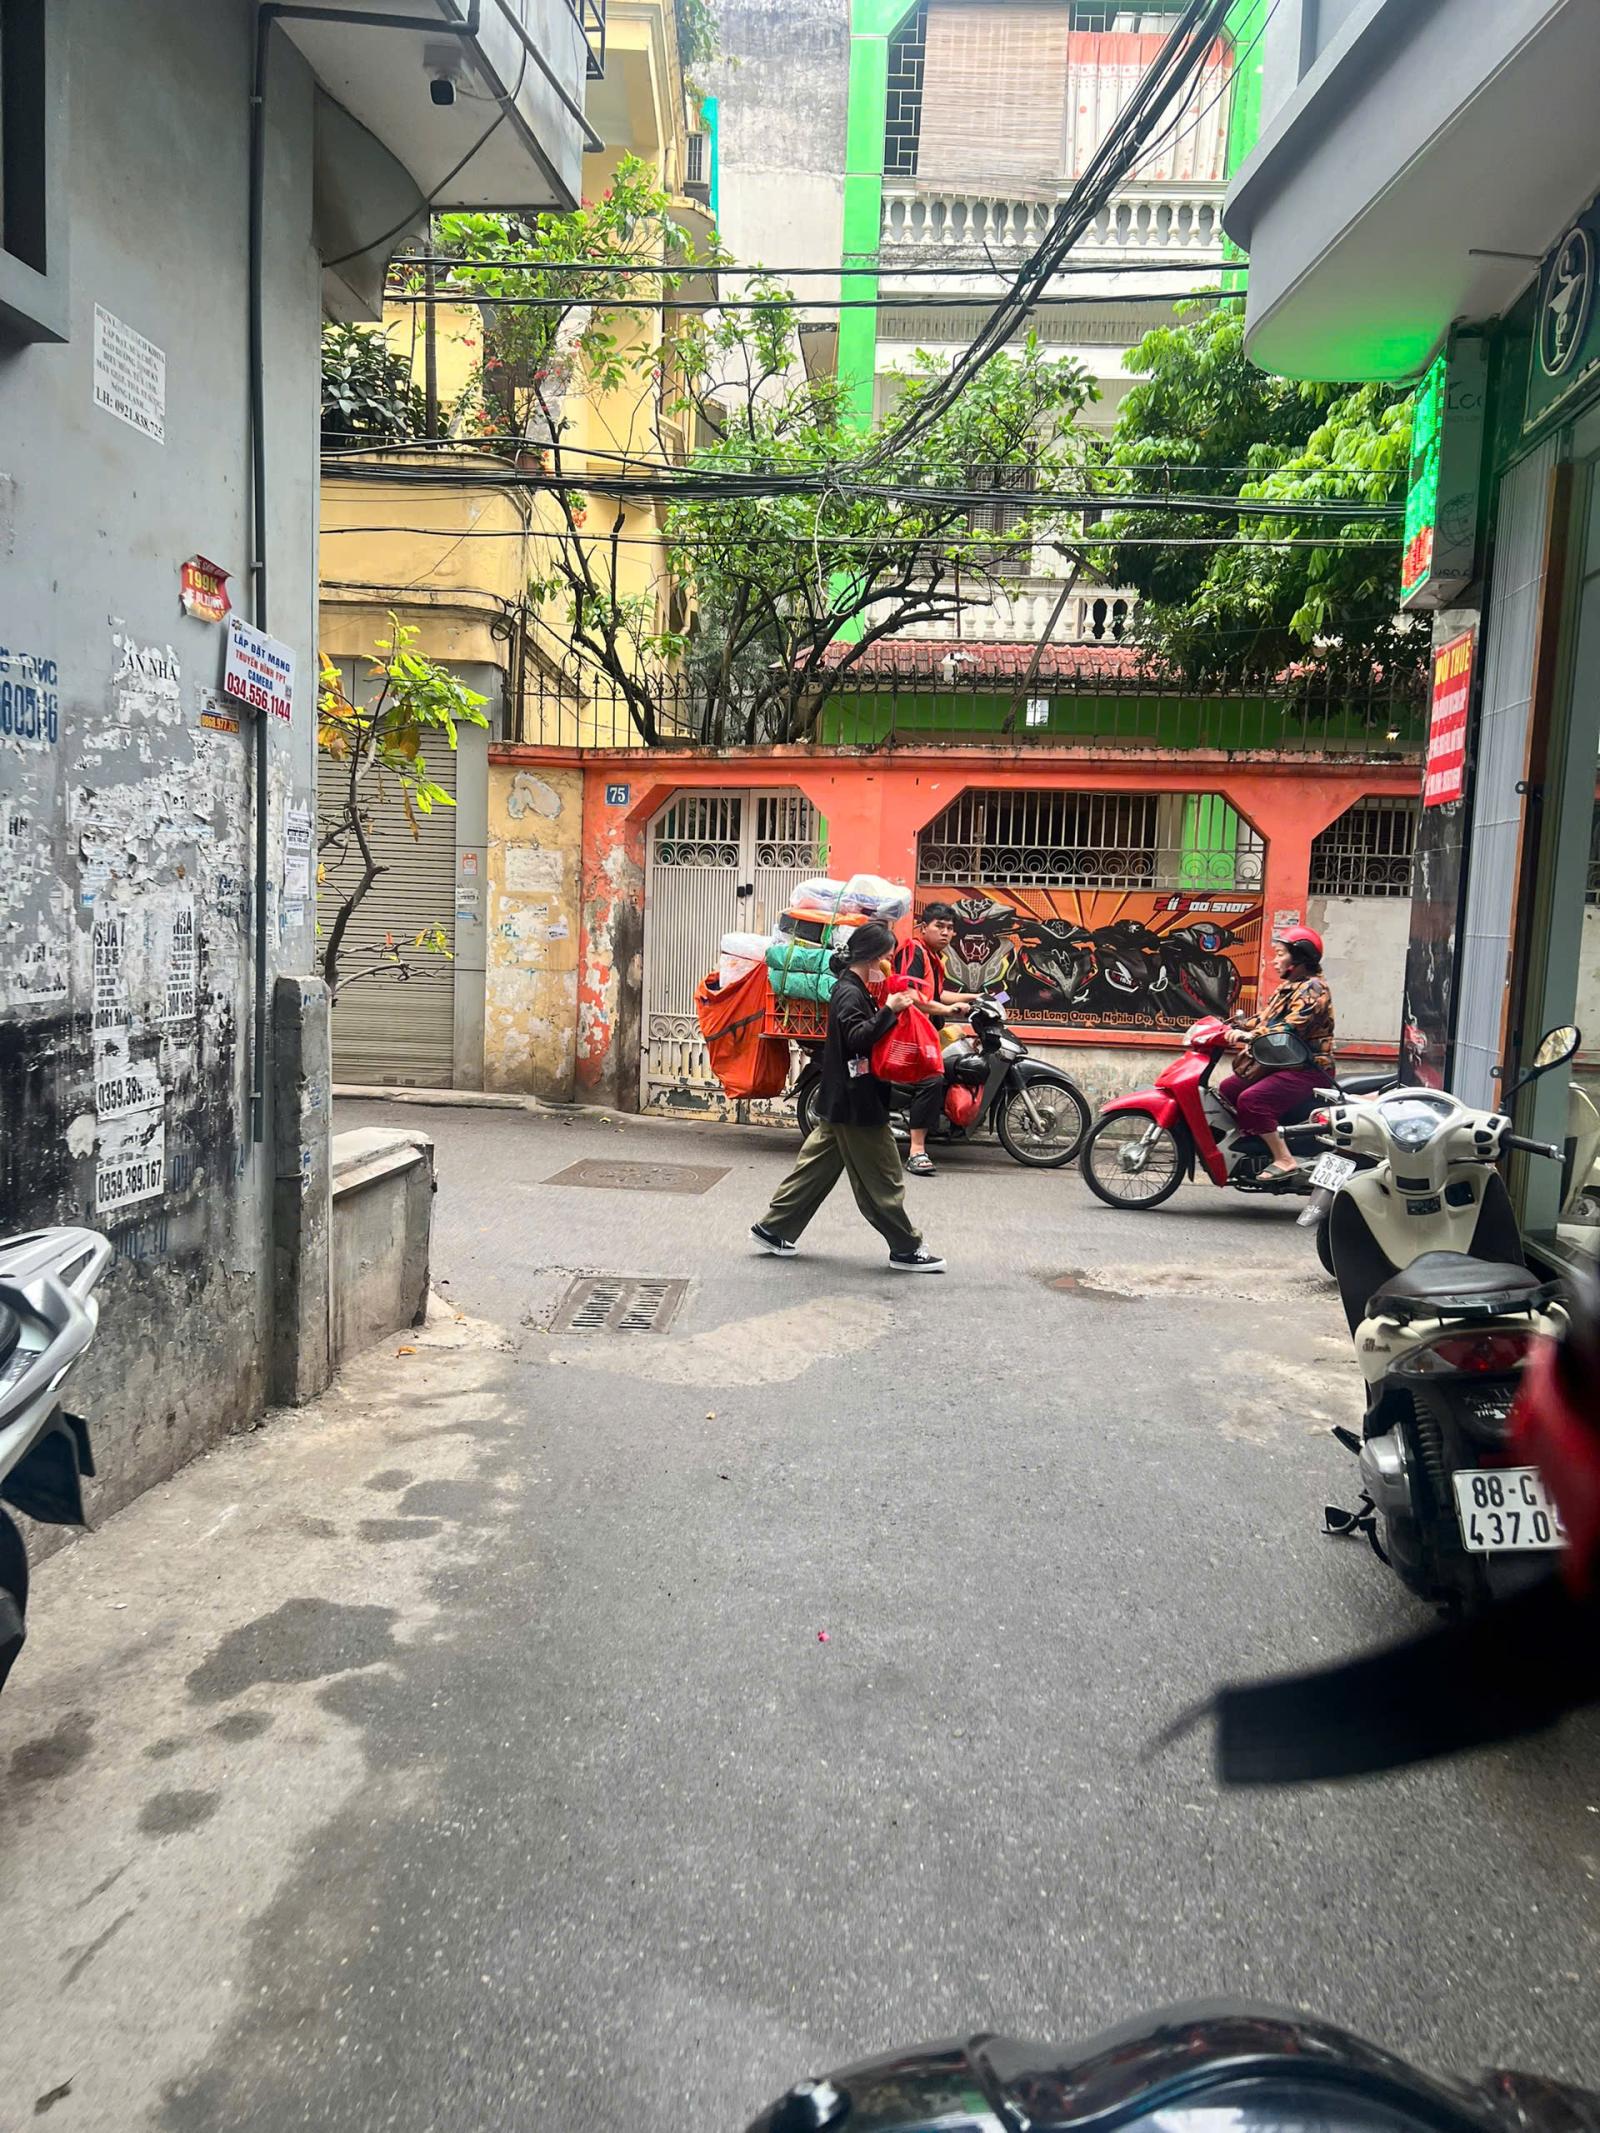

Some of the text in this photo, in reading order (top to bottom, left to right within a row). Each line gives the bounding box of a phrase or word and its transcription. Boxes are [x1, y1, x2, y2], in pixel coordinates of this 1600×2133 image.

[96, 386, 113, 408] LH:
[187, 568, 219, 595] 199K
[248, 669, 273, 692] CAMERA
[227, 671, 291, 722] 034.556.1144
[610, 786, 626, 803] 75
[1043, 1009, 1068, 1024] Long
[98, 1159, 162, 1203] 0359.389.167
[1471, 1474, 1544, 1509] 88-G
